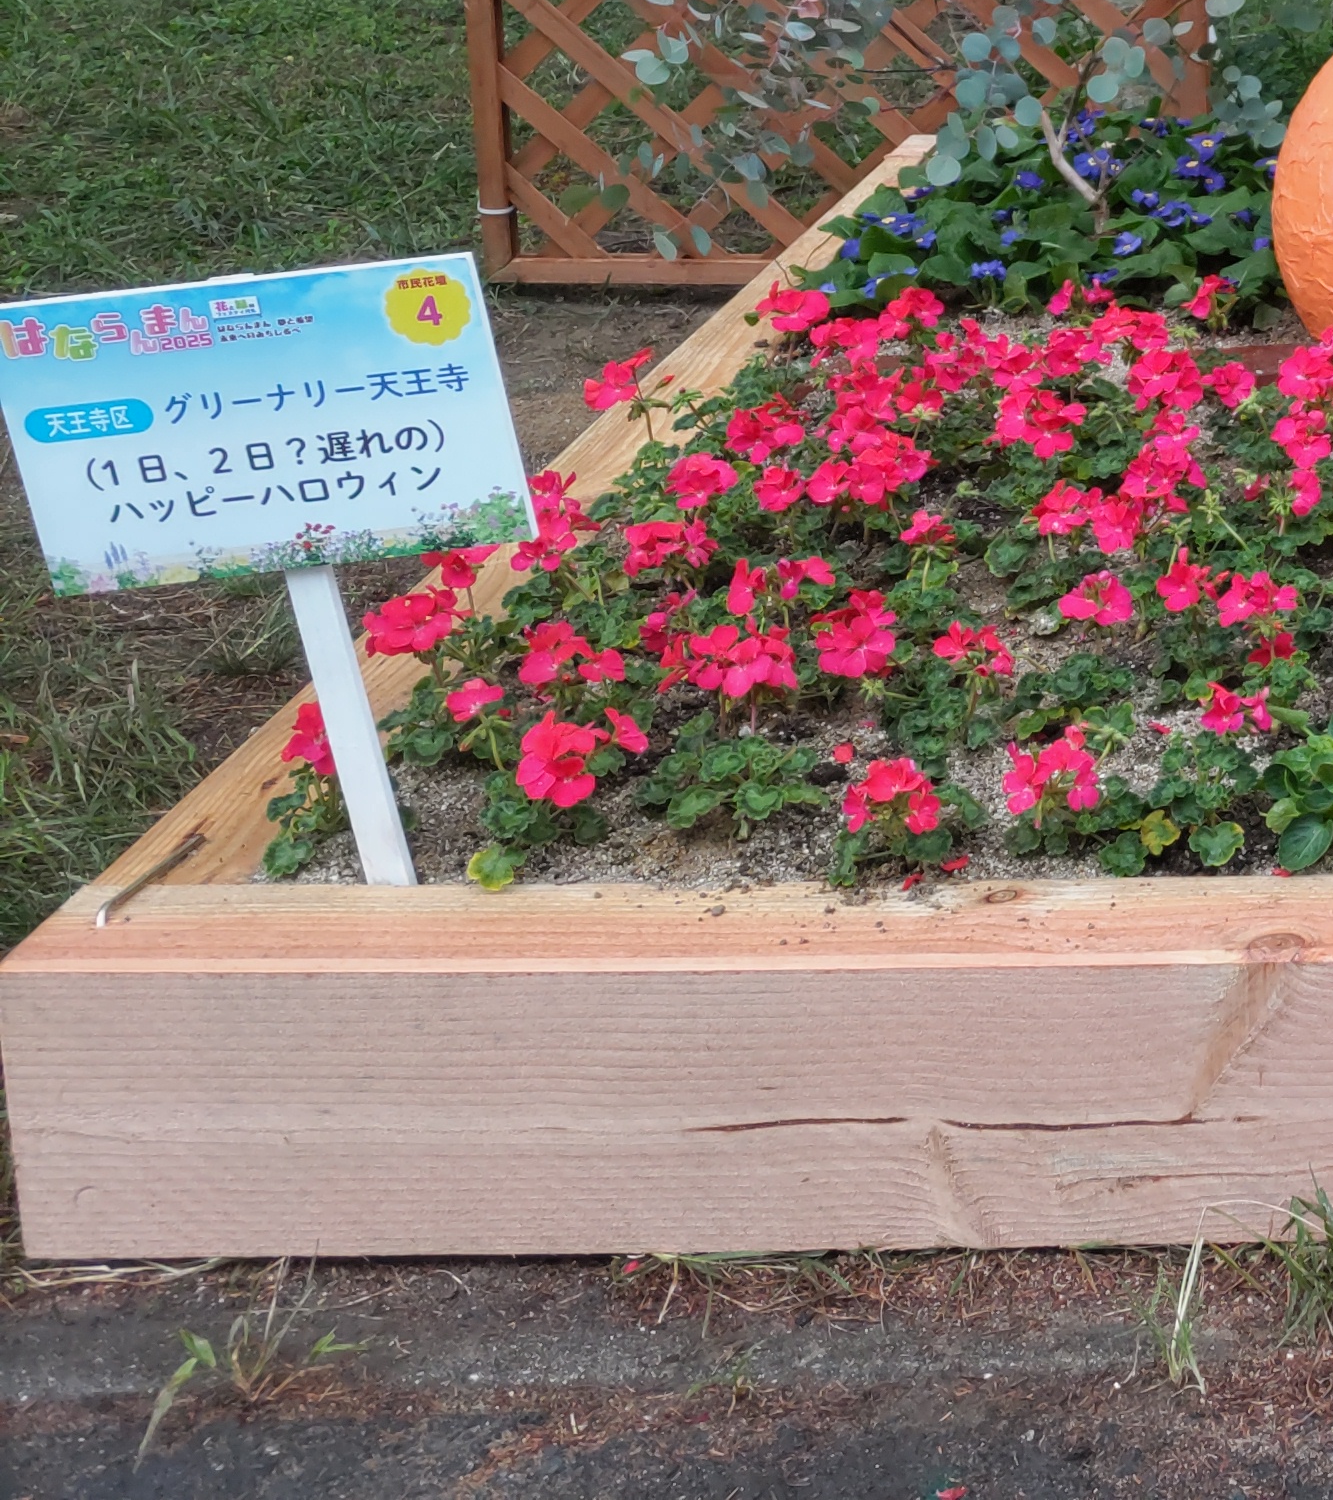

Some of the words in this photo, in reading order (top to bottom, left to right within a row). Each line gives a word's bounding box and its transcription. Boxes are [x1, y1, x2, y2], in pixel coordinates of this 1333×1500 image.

[397, 275, 448, 290] 市民花壇
[416, 294, 444, 327] 4
[160, 332, 214, 352] 2025
[45, 405, 133, 438] 天王寺区
[164, 362, 471, 425] グリーナリー天王寺
[109, 465, 443, 524] ハッピーハロウィン
